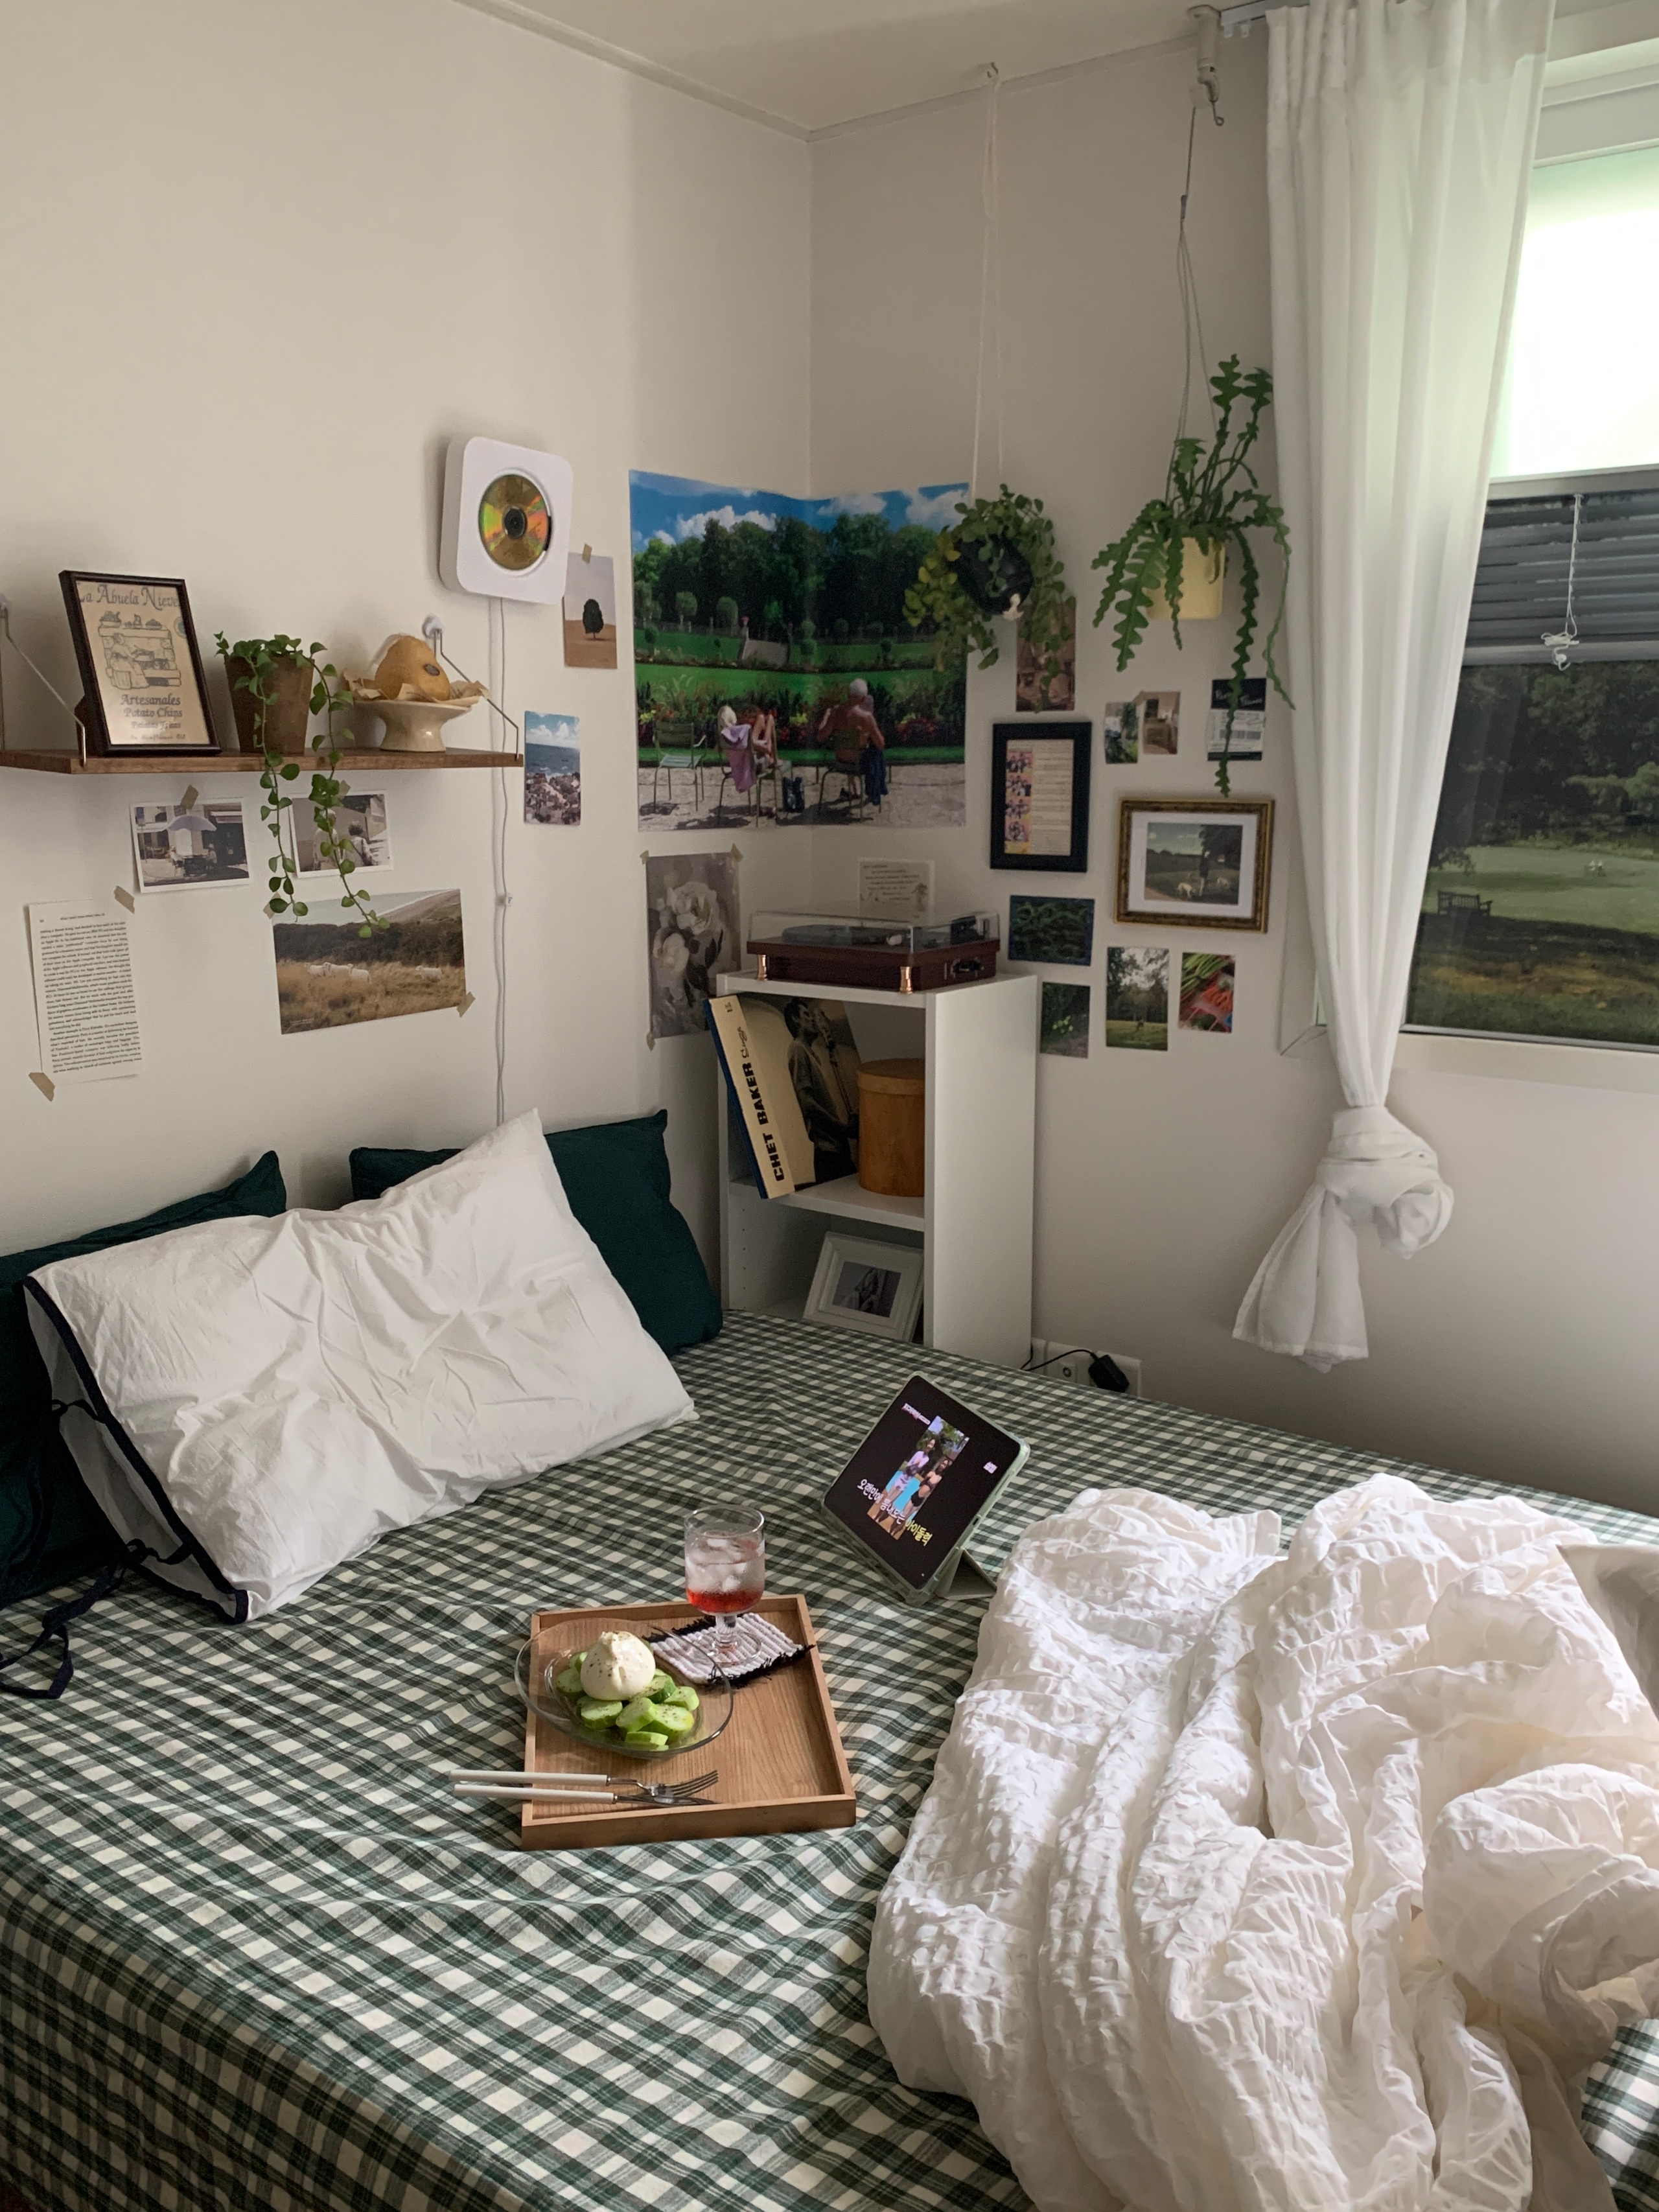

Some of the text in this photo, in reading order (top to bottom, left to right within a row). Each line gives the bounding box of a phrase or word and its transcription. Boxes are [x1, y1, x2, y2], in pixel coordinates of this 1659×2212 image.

[97, 584, 139, 605] Abuela
[120, 692, 181, 706] Artesanales
[124, 706, 183, 721] Potato Chips
[742, 1062, 769, 1126] BAKER
[762, 1133, 785, 1182] CHET
[857, 1478, 884, 1504] 오랜만에
